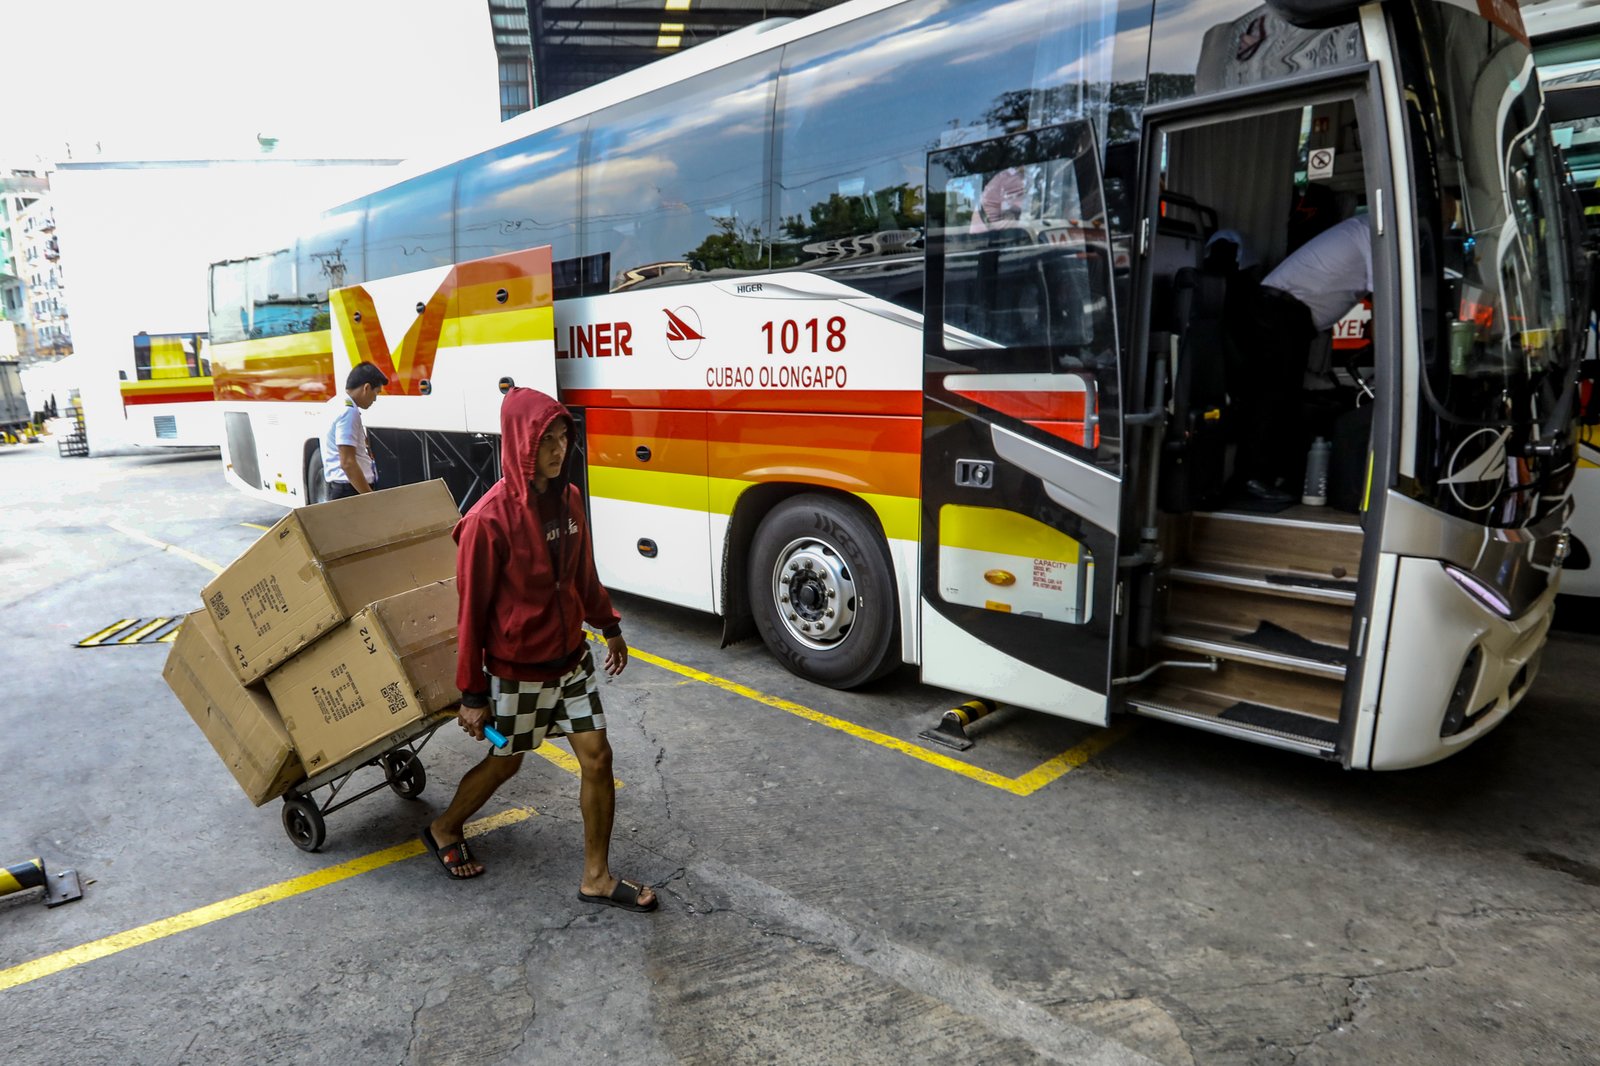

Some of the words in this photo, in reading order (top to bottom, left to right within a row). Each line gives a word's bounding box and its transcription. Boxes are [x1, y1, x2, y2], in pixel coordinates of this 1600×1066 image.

[737, 283, 763, 293] HIGER
[554, 322, 633, 359] LINER
[761, 315, 847, 354] 1018
[706, 366, 754, 387] CUBAO
[759, 365, 847, 388] OLONGAPO
[1033, 558, 1067, 569] CAPACITY
[359, 626, 377, 655] K12
[234, 645, 249, 670] K12
